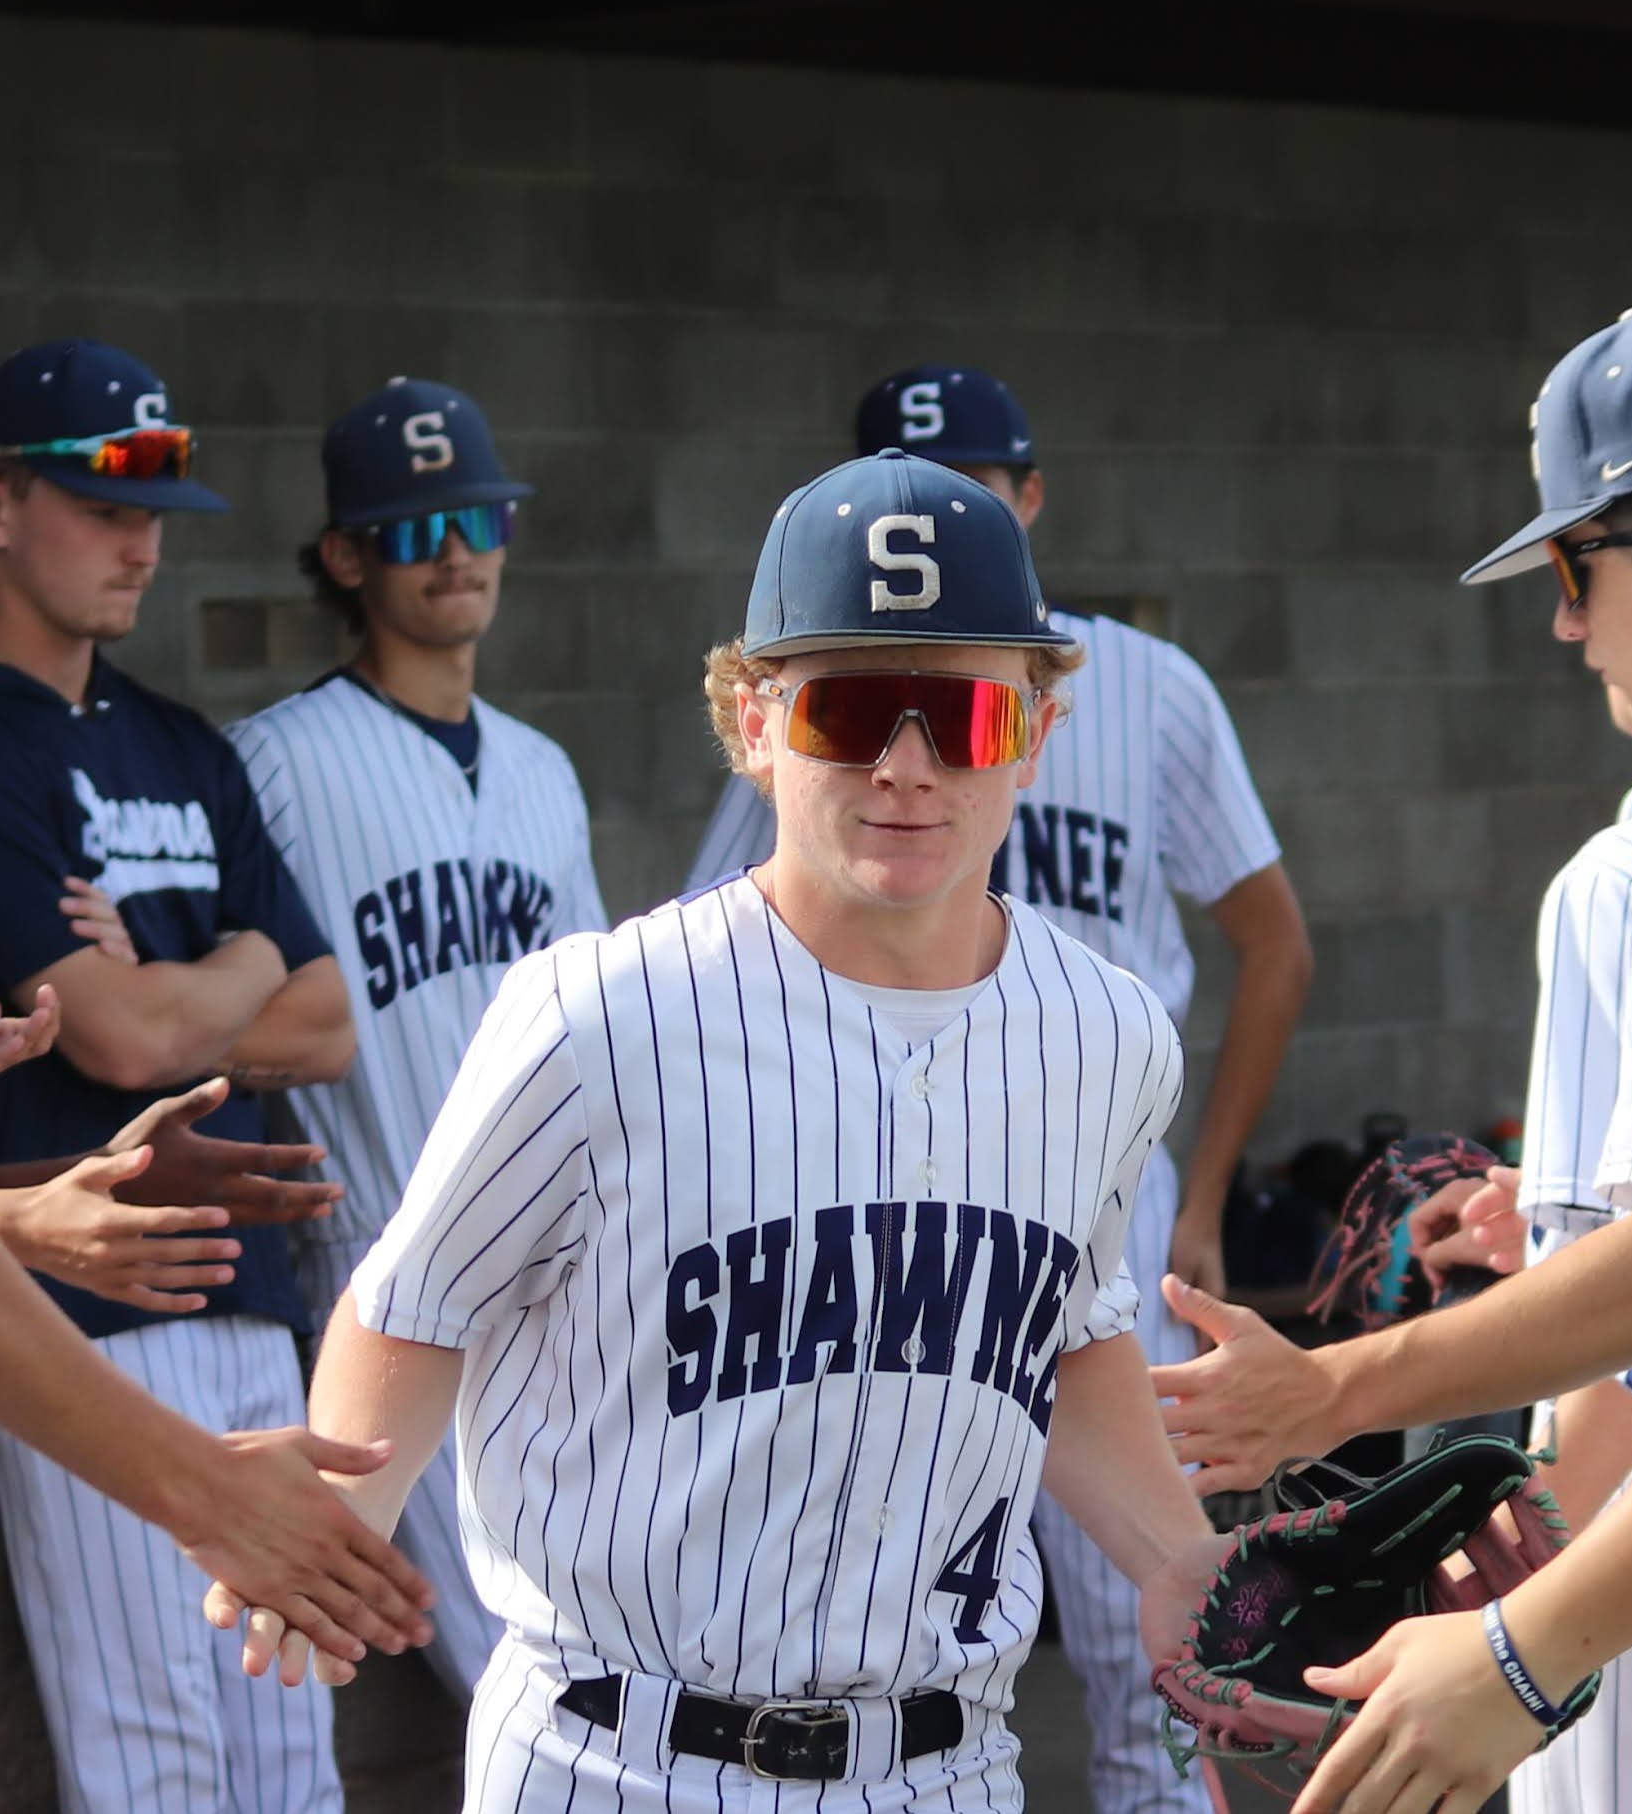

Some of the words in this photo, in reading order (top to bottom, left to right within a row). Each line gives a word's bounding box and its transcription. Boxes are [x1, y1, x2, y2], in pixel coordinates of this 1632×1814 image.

[403, 411, 454, 474] S
[900, 382, 944, 441] S
[869, 514, 941, 612] S
[933, 1497, 1011, 1645] 4
